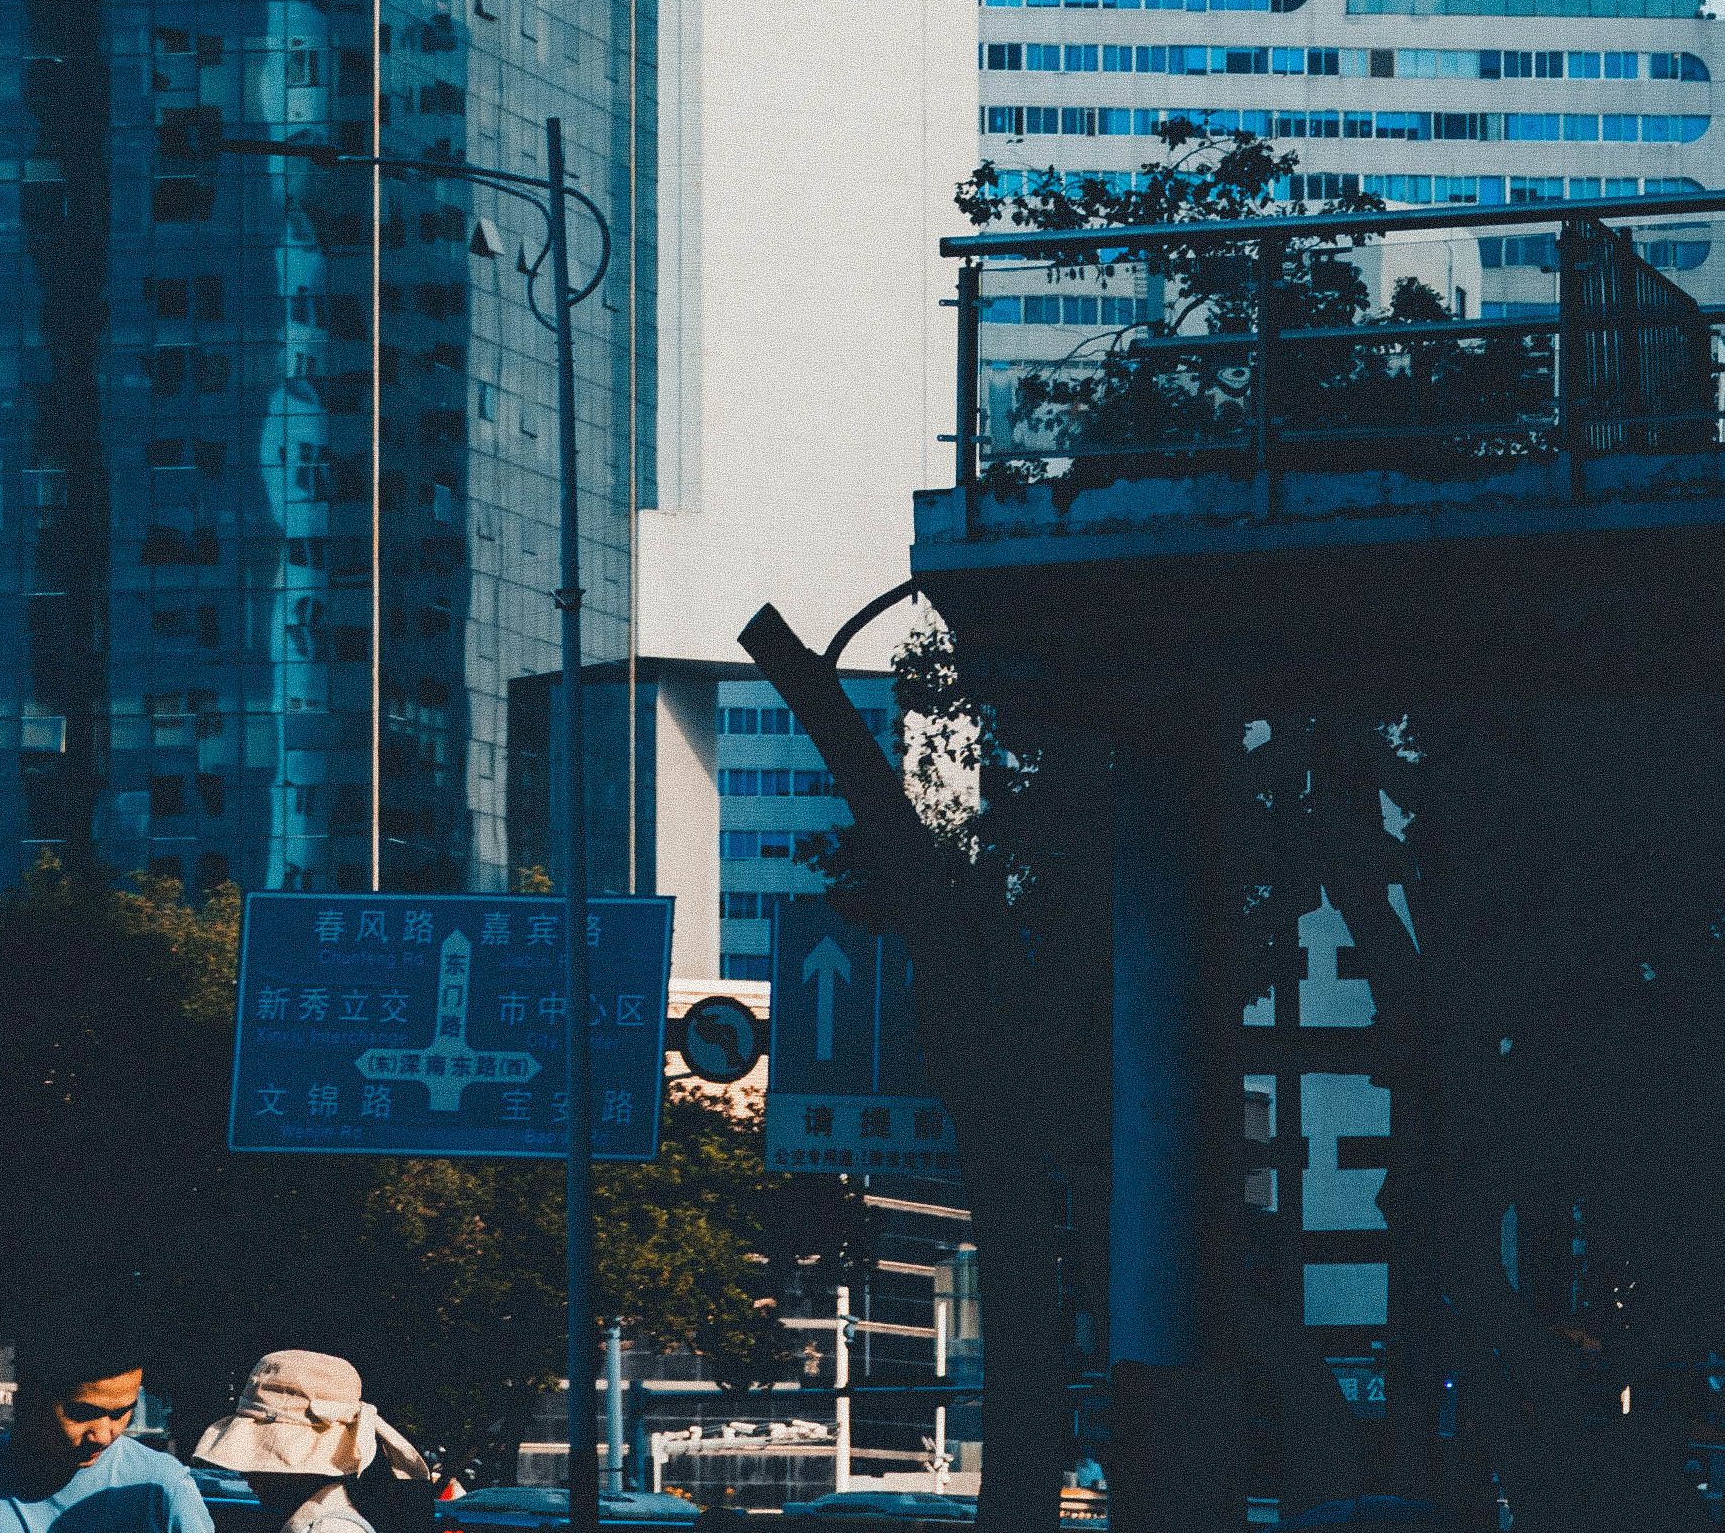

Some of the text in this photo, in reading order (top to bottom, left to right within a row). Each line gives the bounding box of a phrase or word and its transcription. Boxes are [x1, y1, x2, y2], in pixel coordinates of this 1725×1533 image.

[313, 909, 434, 945] 春风路
[256, 985, 411, 1025] 新秀立交
[441, 953, 468, 1038] 东门路
[255, 1082, 394, 1119] 文锦路
